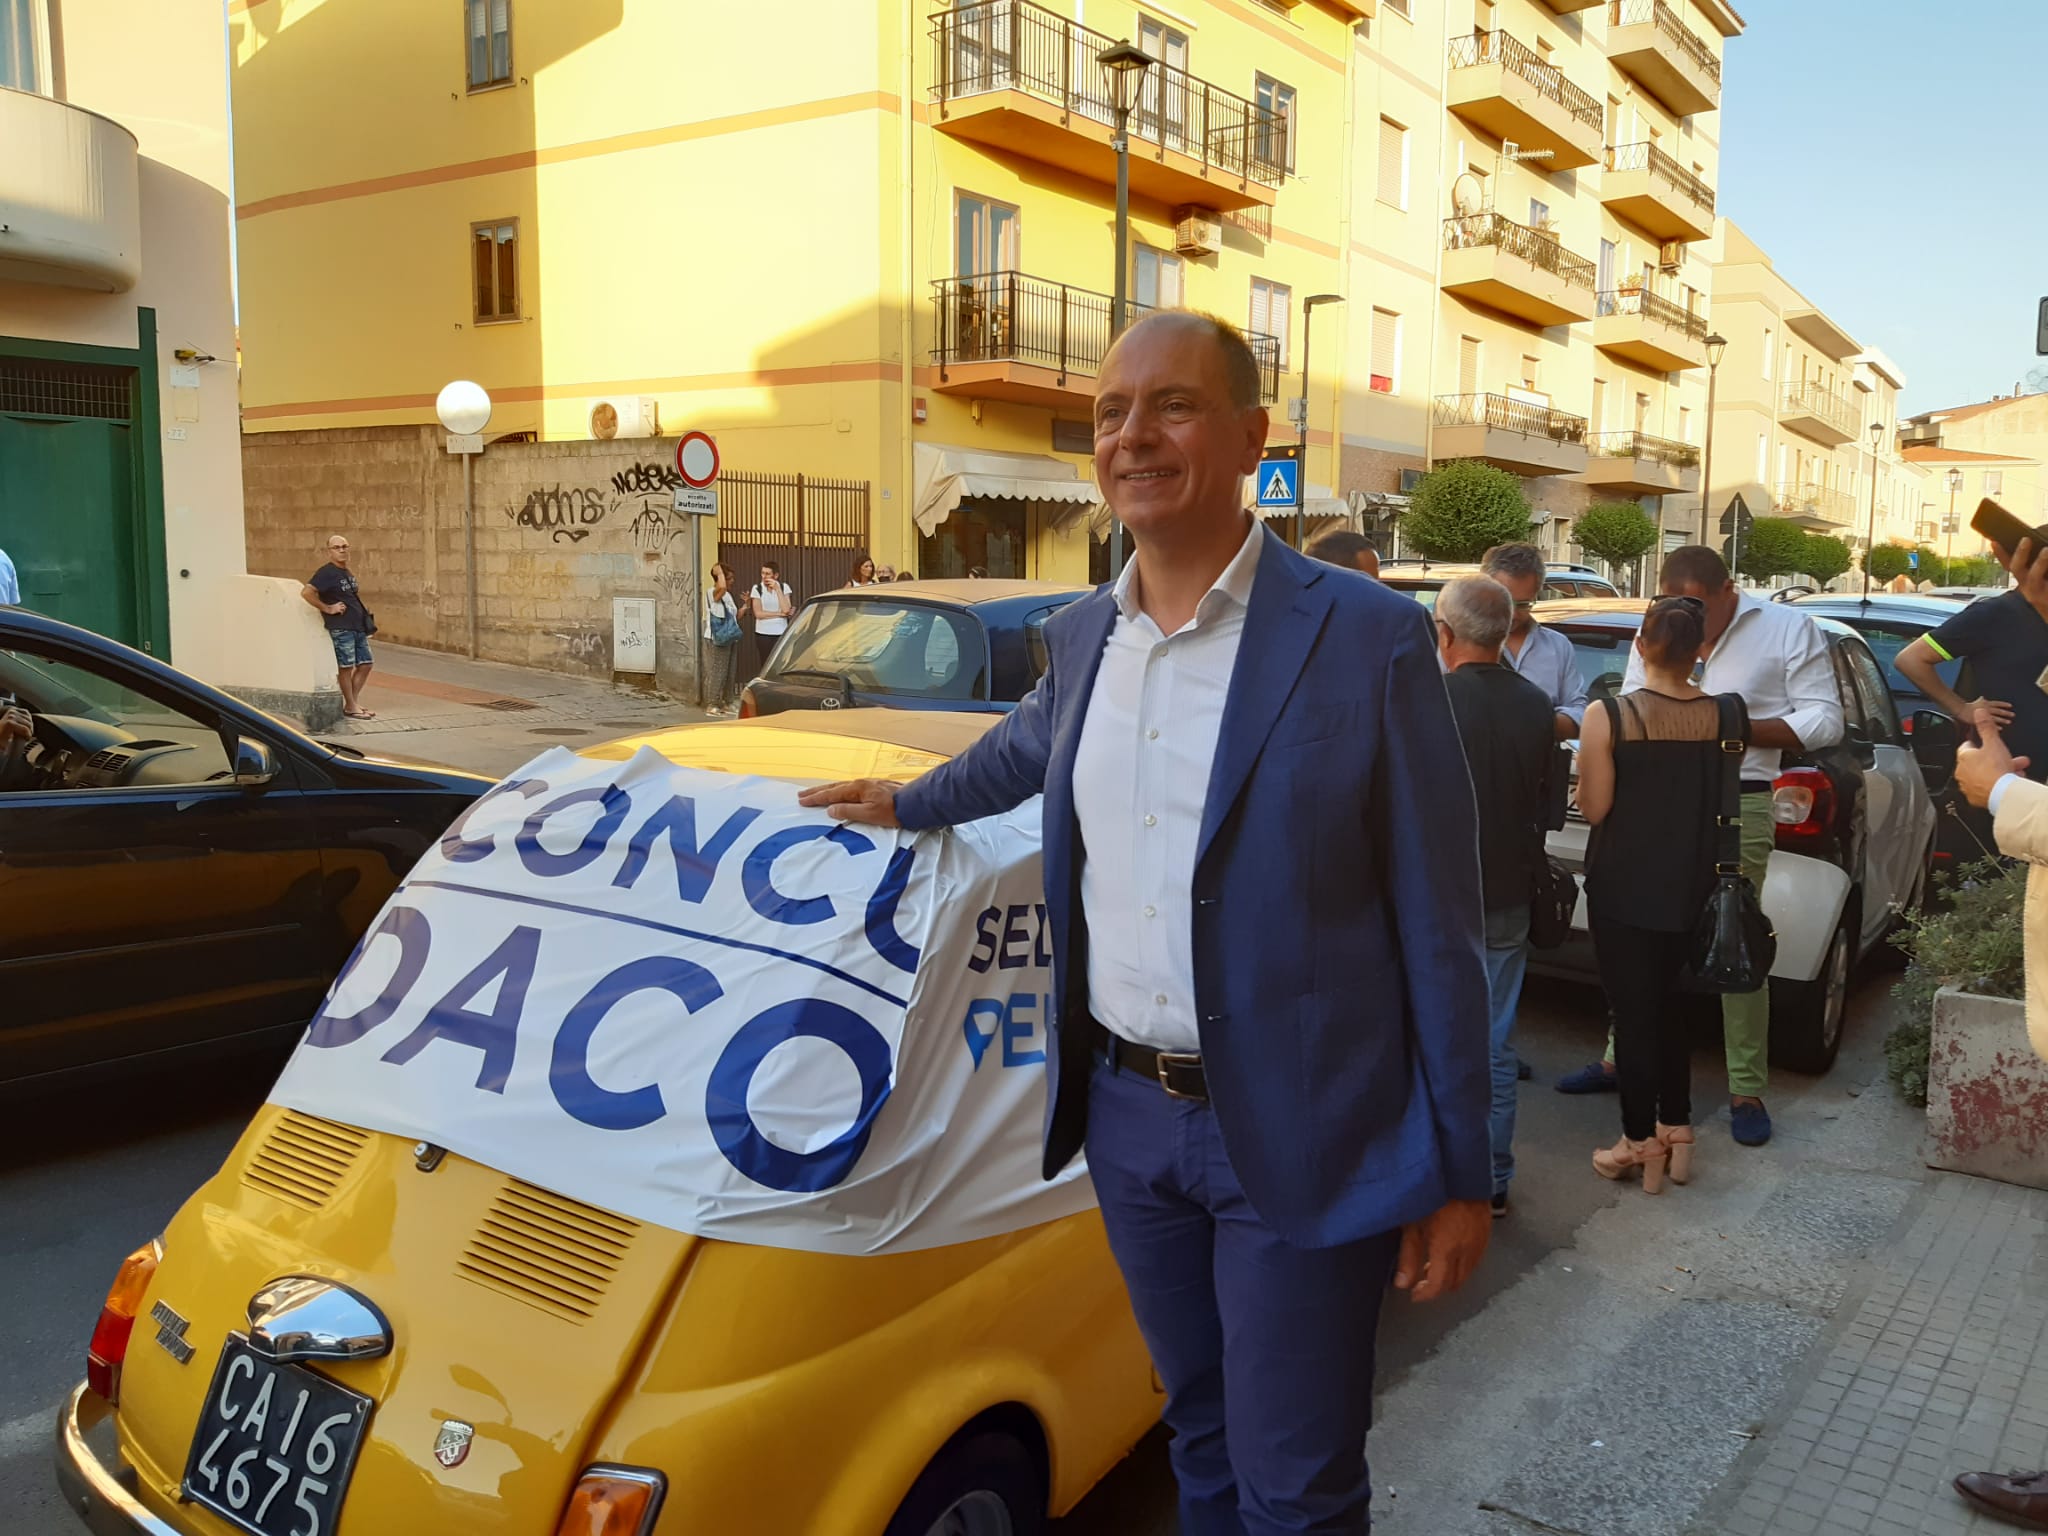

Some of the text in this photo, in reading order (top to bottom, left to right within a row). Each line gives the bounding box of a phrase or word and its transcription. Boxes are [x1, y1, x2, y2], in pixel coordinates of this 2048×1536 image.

[678, 501, 715, 510] autorizzati
[963, 993, 1050, 1073] PE
[198, 1428, 329, 1536] 4675
